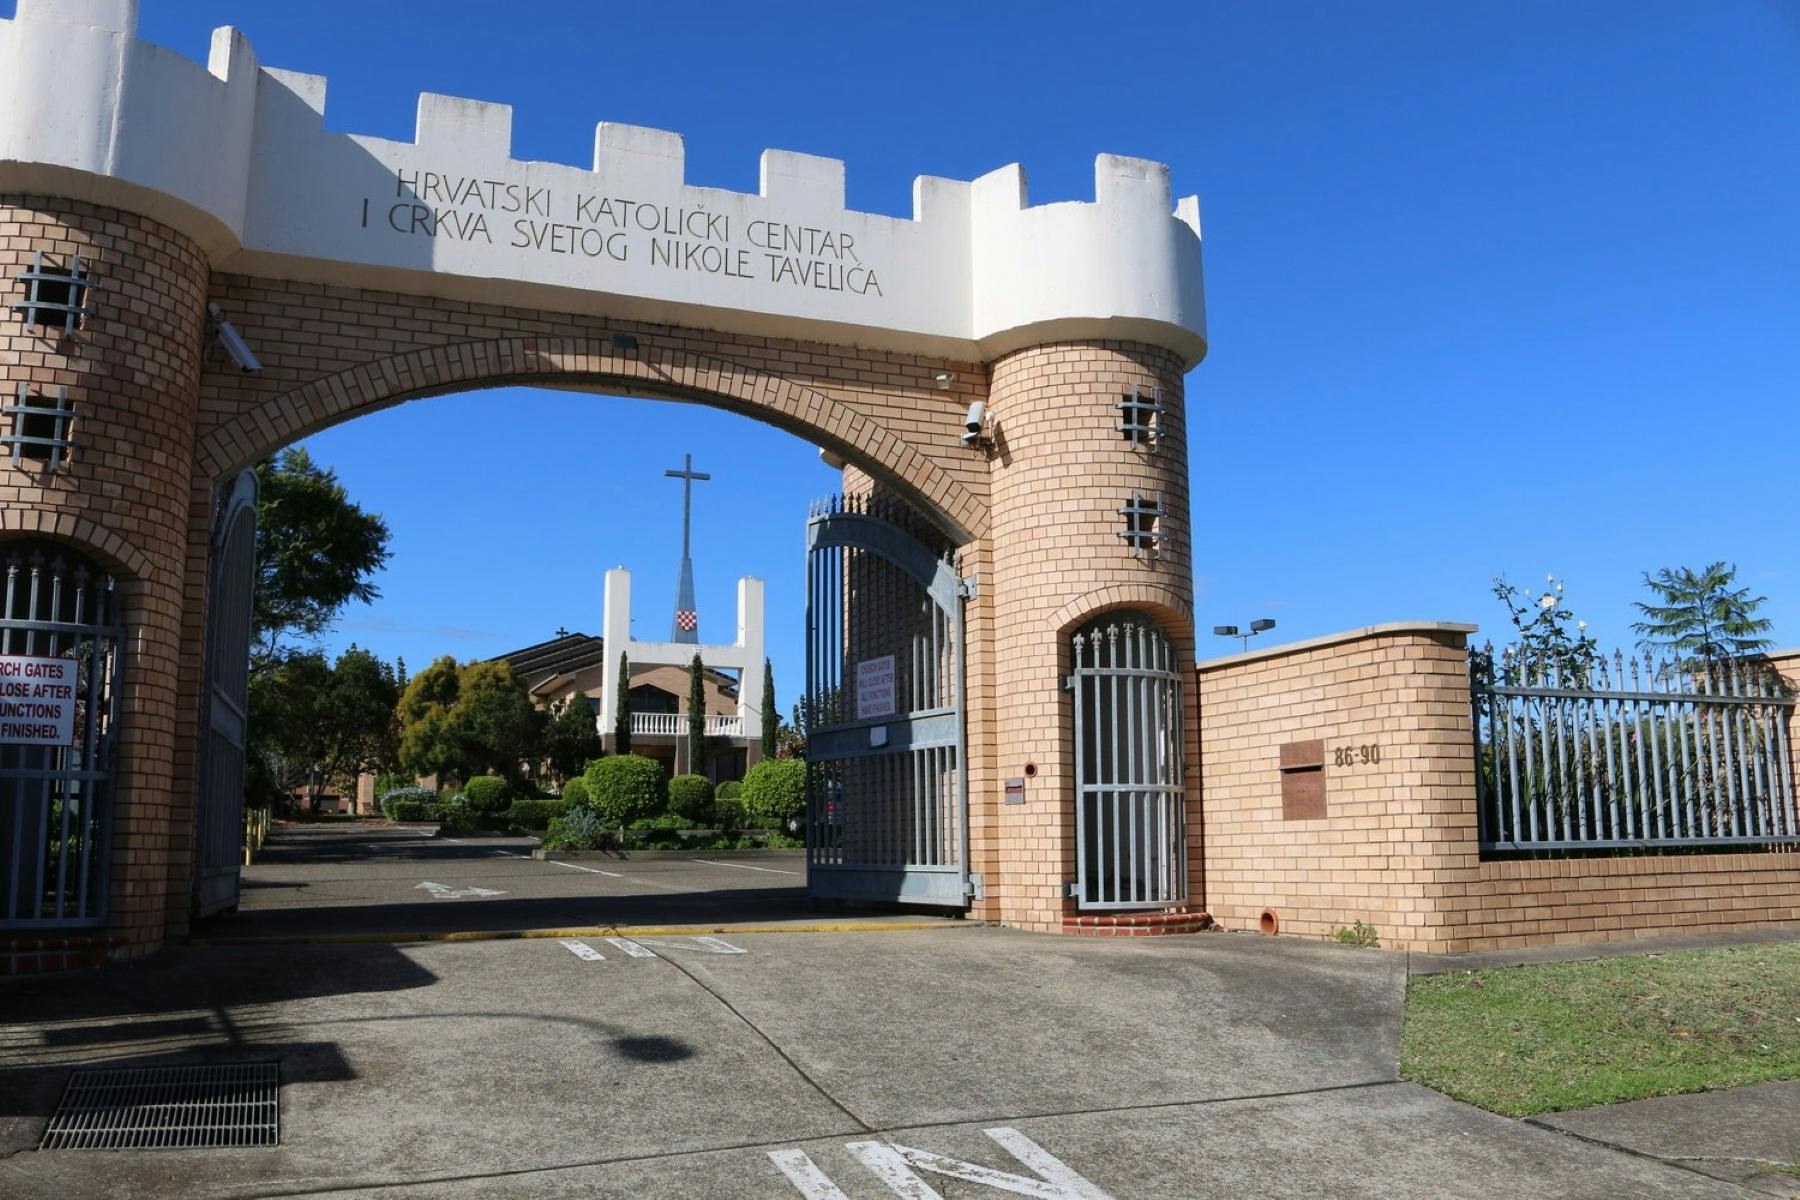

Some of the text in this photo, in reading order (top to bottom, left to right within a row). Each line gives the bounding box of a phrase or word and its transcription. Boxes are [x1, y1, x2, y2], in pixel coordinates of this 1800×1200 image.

[396, 168, 859, 262] HRVATSKI KATOLIČKI CENTAR
[361, 198, 883, 297] I CRKVA SVETOG NIKOLE TAVELIĆA
[25, 662, 64, 679] GATES
[33, 683, 72, 699] AFTER
[1334, 743, 1381, 768] 86-90
